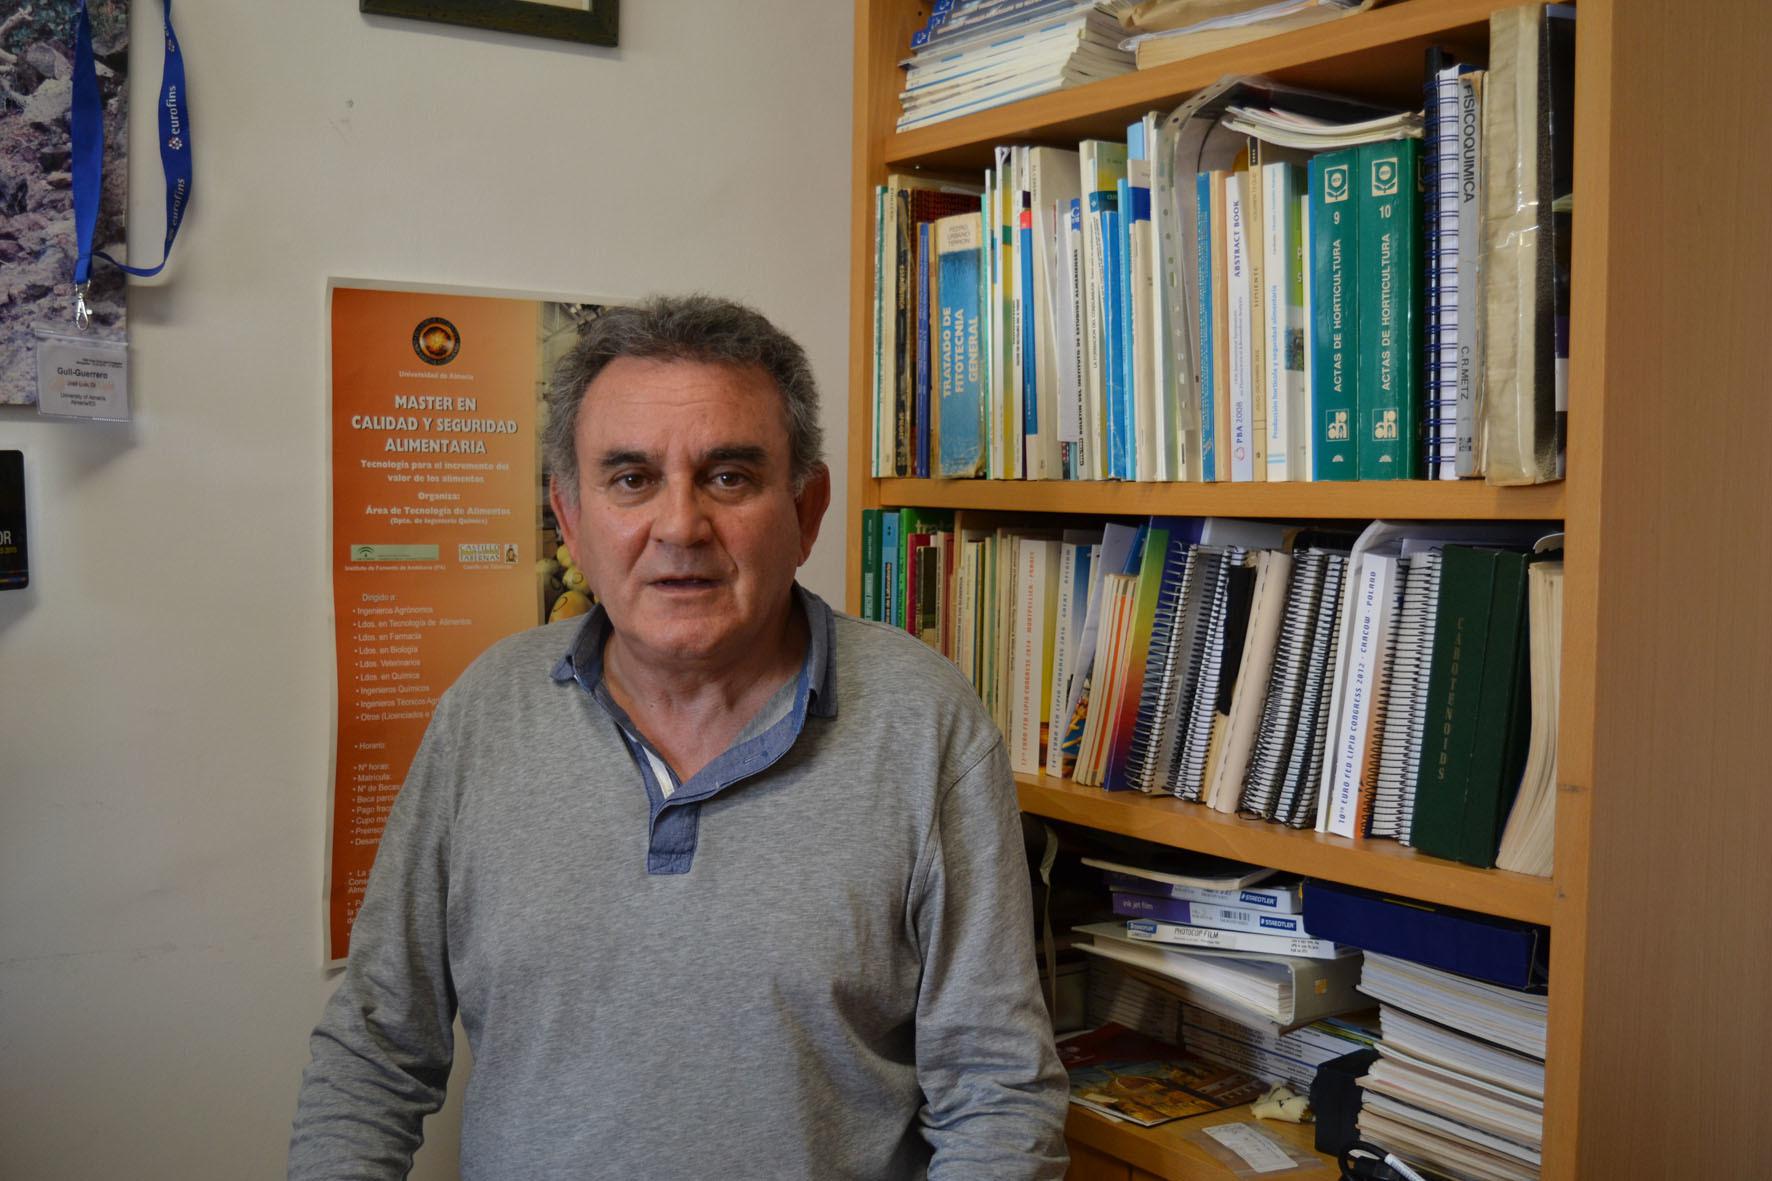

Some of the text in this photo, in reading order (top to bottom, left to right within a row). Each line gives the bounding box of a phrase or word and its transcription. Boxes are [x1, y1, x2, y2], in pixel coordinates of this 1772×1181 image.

[166, 85, 181, 135] eurofins
[1463, 84, 1476, 203] FISICOQUIMICA
[172, 177, 185, 226] eurofins
[1232, 200, 1240, 227] BOOK
[1333, 210, 1340, 225] 9
[1379, 204, 1391, 219] 10
[1332, 239, 1342, 393] ACTAS DE HORTICULTURA
[1380, 233, 1391, 391] ACTAS DE HORTICULTURA
[942, 306, 952, 399] TRATADO DE
[954, 308, 964, 393] FITOTECNIA
[967, 315, 978, 383] GENERAL
[399, 370, 438, 378] Universidad
[395, 395, 477, 411] MASTER EN
[1235, 401, 1243, 424] 2008
[352, 415, 518, 433] CALIDAD Y SEGURIDAD
[385, 438, 487, 454] ALIMENTARIA
[411, 462, 432, 472] para
[434, 461, 442, 469] el
[444, 462, 494, 470] incremento
[387, 473, 484, 483] valor de los alimentos
[418, 492, 461, 501] Organiza:
[366, 504, 388, 515] Área
[390, 506, 401, 515] de
[454, 507, 465, 515] de
[467, 507, 511, 516] Alimentos
[1366, 571, 1376, 607] POLAND
[362, 593, 390, 602] Dirigido
[357, 607, 393, 616] Ingenieros
[439, 617, 472, 626] Alimentos
[358, 634, 377, 642] Ldos.
[1360, 616, 1370, 654] CRACOW
[1356, 662, 1365, 685] 2012
[360, 687, 396, 696] Ingenieros
[1437, 616, 1465, 780] CAROTENOIDS
[360, 701, 396, 709] Ingenieros
[1350, 688, 1362, 732] CONGRESS
[360, 713, 380, 721] Otros
[1346, 735, 1356, 760] LIPID
[1344, 762, 1352, 780] FED
[368, 784, 376, 792] de
[1342, 781, 1350, 804] EURO
[1245, 893, 1276, 905] STAEDTLER
[1264, 918, 1296, 929] STAEDTLER
[1203, 930, 1218, 939] FILM
